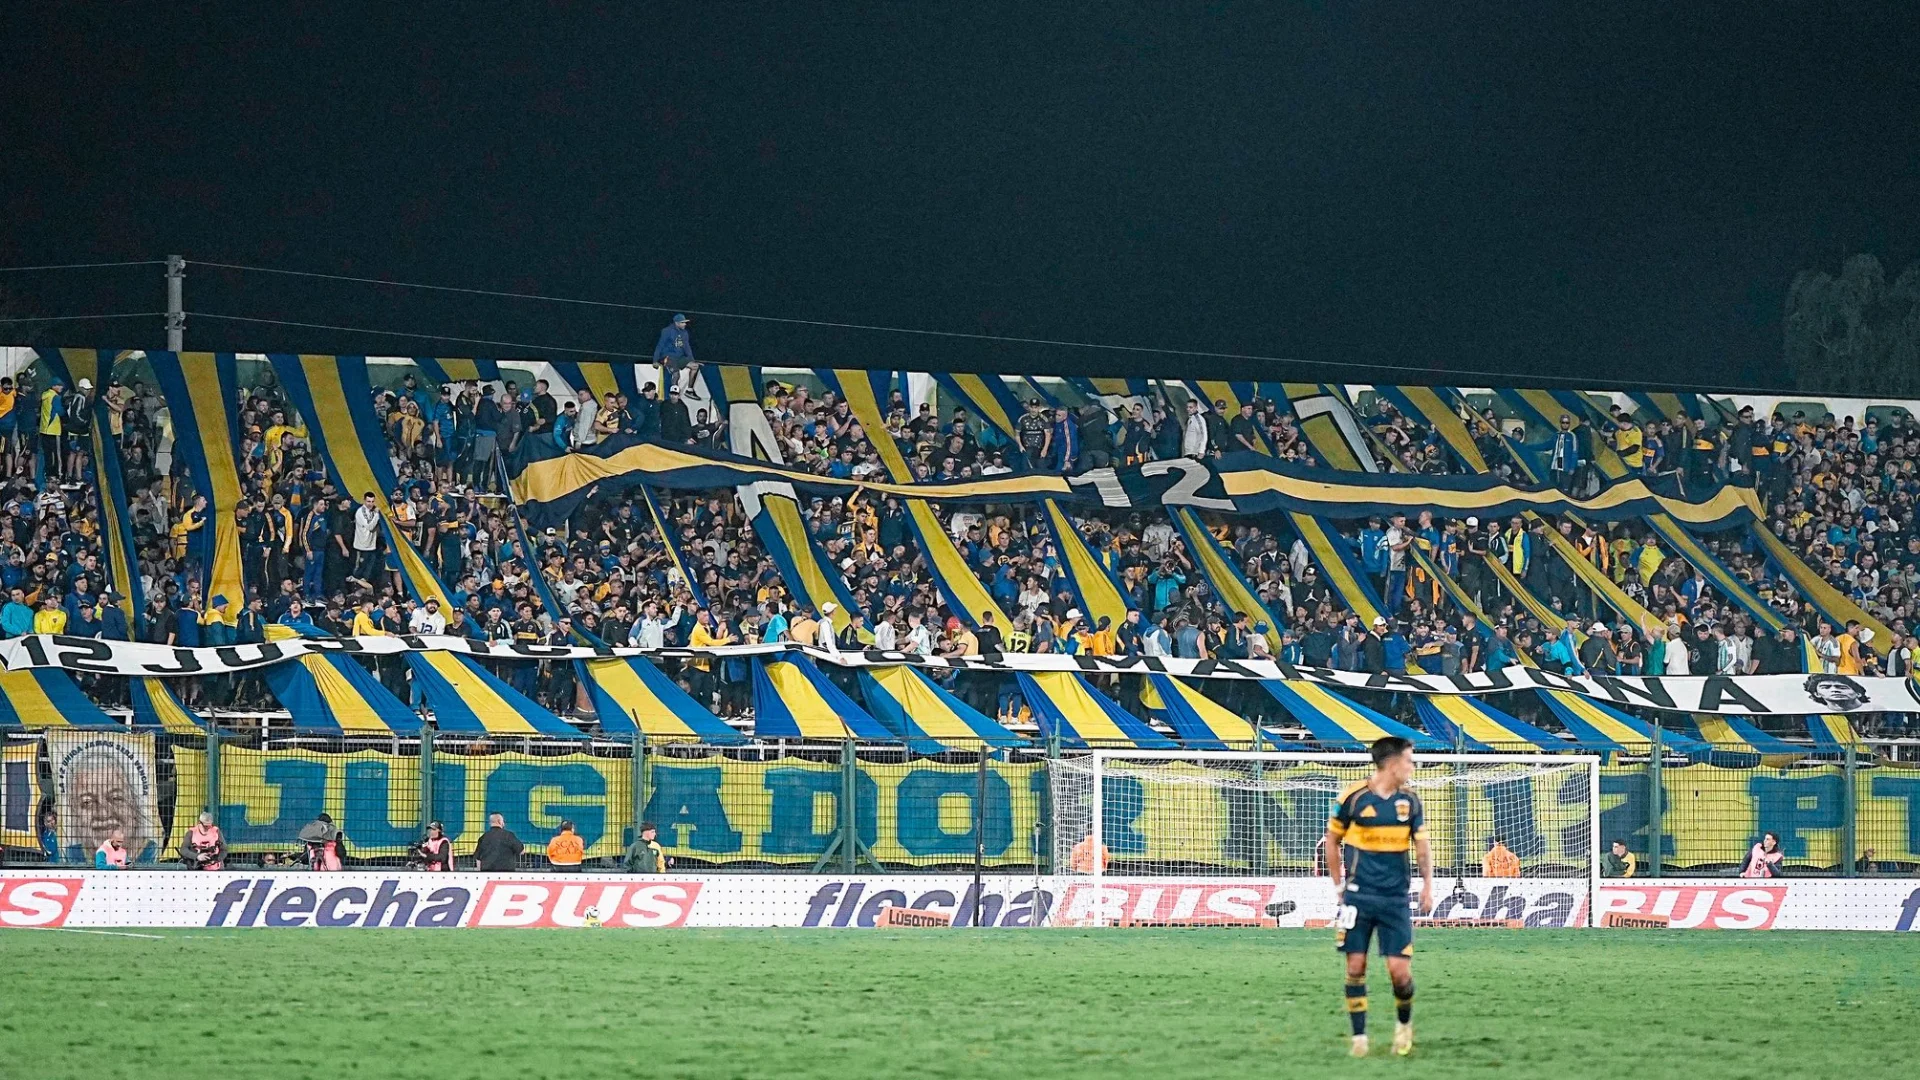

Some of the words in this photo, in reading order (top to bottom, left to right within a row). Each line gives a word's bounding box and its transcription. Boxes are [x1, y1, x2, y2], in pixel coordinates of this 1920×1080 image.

[1068, 457, 1237, 511] 12
[20, 635, 118, 673] 12
[1010, 638, 1027, 653] 12
[62, 746, 83, 767] UNIDA
[134, 760, 148, 796] VENCIDA
[220, 760, 1147, 857] JUGADOR
